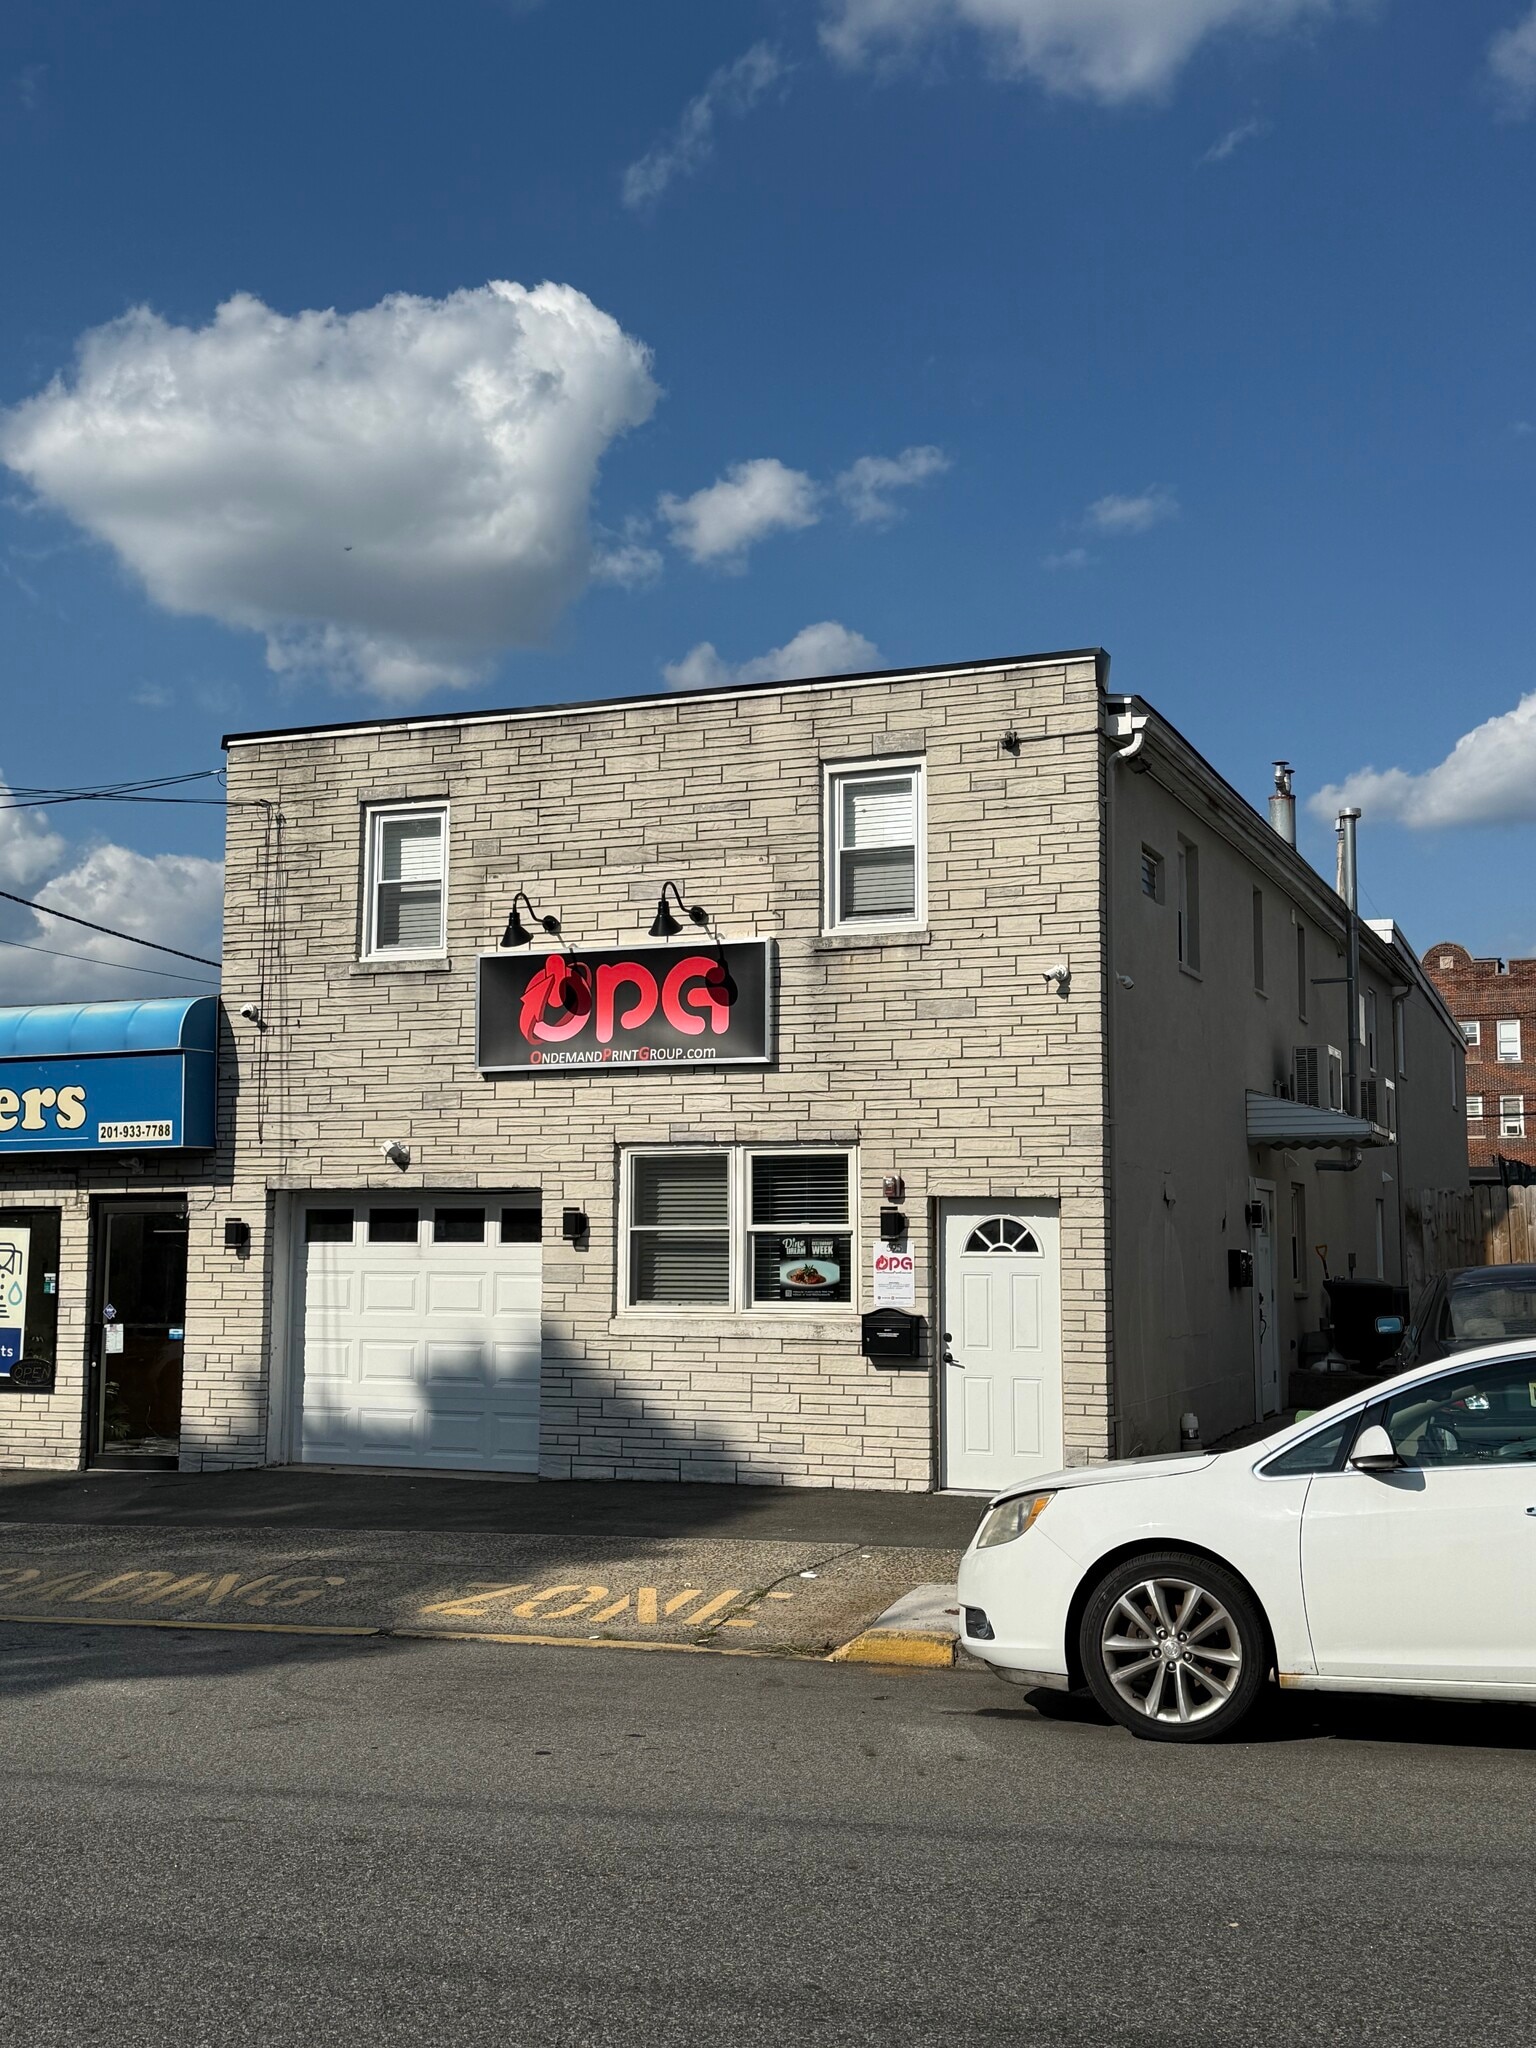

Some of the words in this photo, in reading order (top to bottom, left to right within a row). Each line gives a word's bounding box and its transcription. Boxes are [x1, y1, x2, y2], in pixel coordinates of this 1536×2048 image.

[100, 1124, 171, 1139] 201-933-7788
[811, 1245, 834, 1255] WEEK
[875, 1255, 913, 1271] OPG
[14, 1366, 51, 1380] OPEN
[416, 1581, 794, 1628] ZONE
